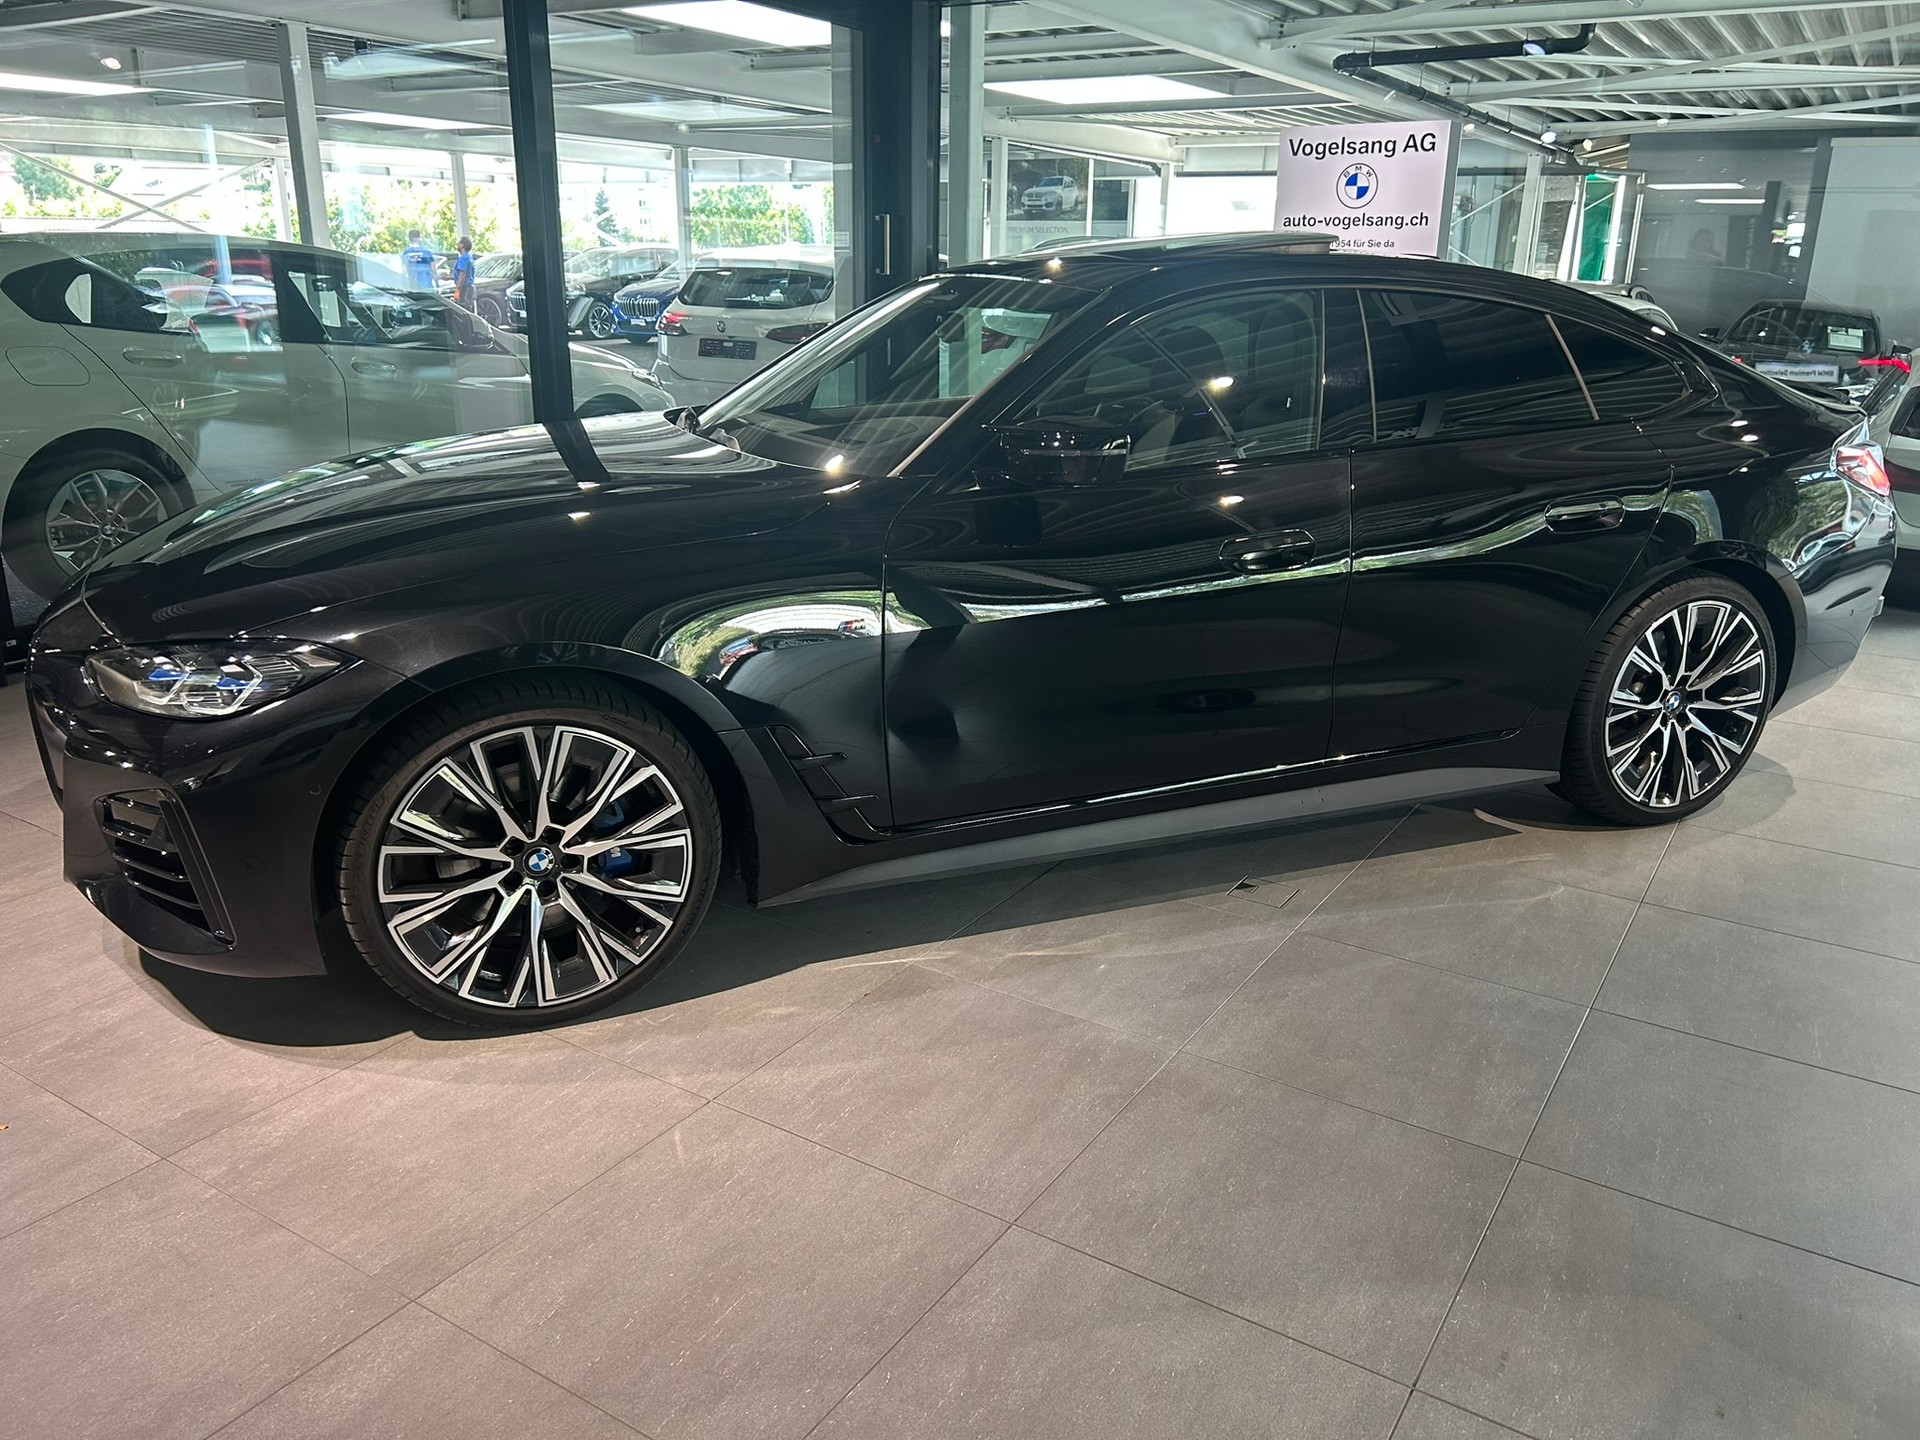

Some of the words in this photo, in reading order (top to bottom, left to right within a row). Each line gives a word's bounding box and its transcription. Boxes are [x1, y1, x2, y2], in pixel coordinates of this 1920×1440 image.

[1288, 136, 1397, 160] Vogelsang
[1403, 132, 1437, 153] AG
[1342, 165, 1374, 178] BMW
[1283, 212, 1429, 230] auto-vogelsang.ch
[1353, 239, 1366, 248] für
[1367, 239, 1382, 248] Sie
[1383, 239, 1395, 248] da
